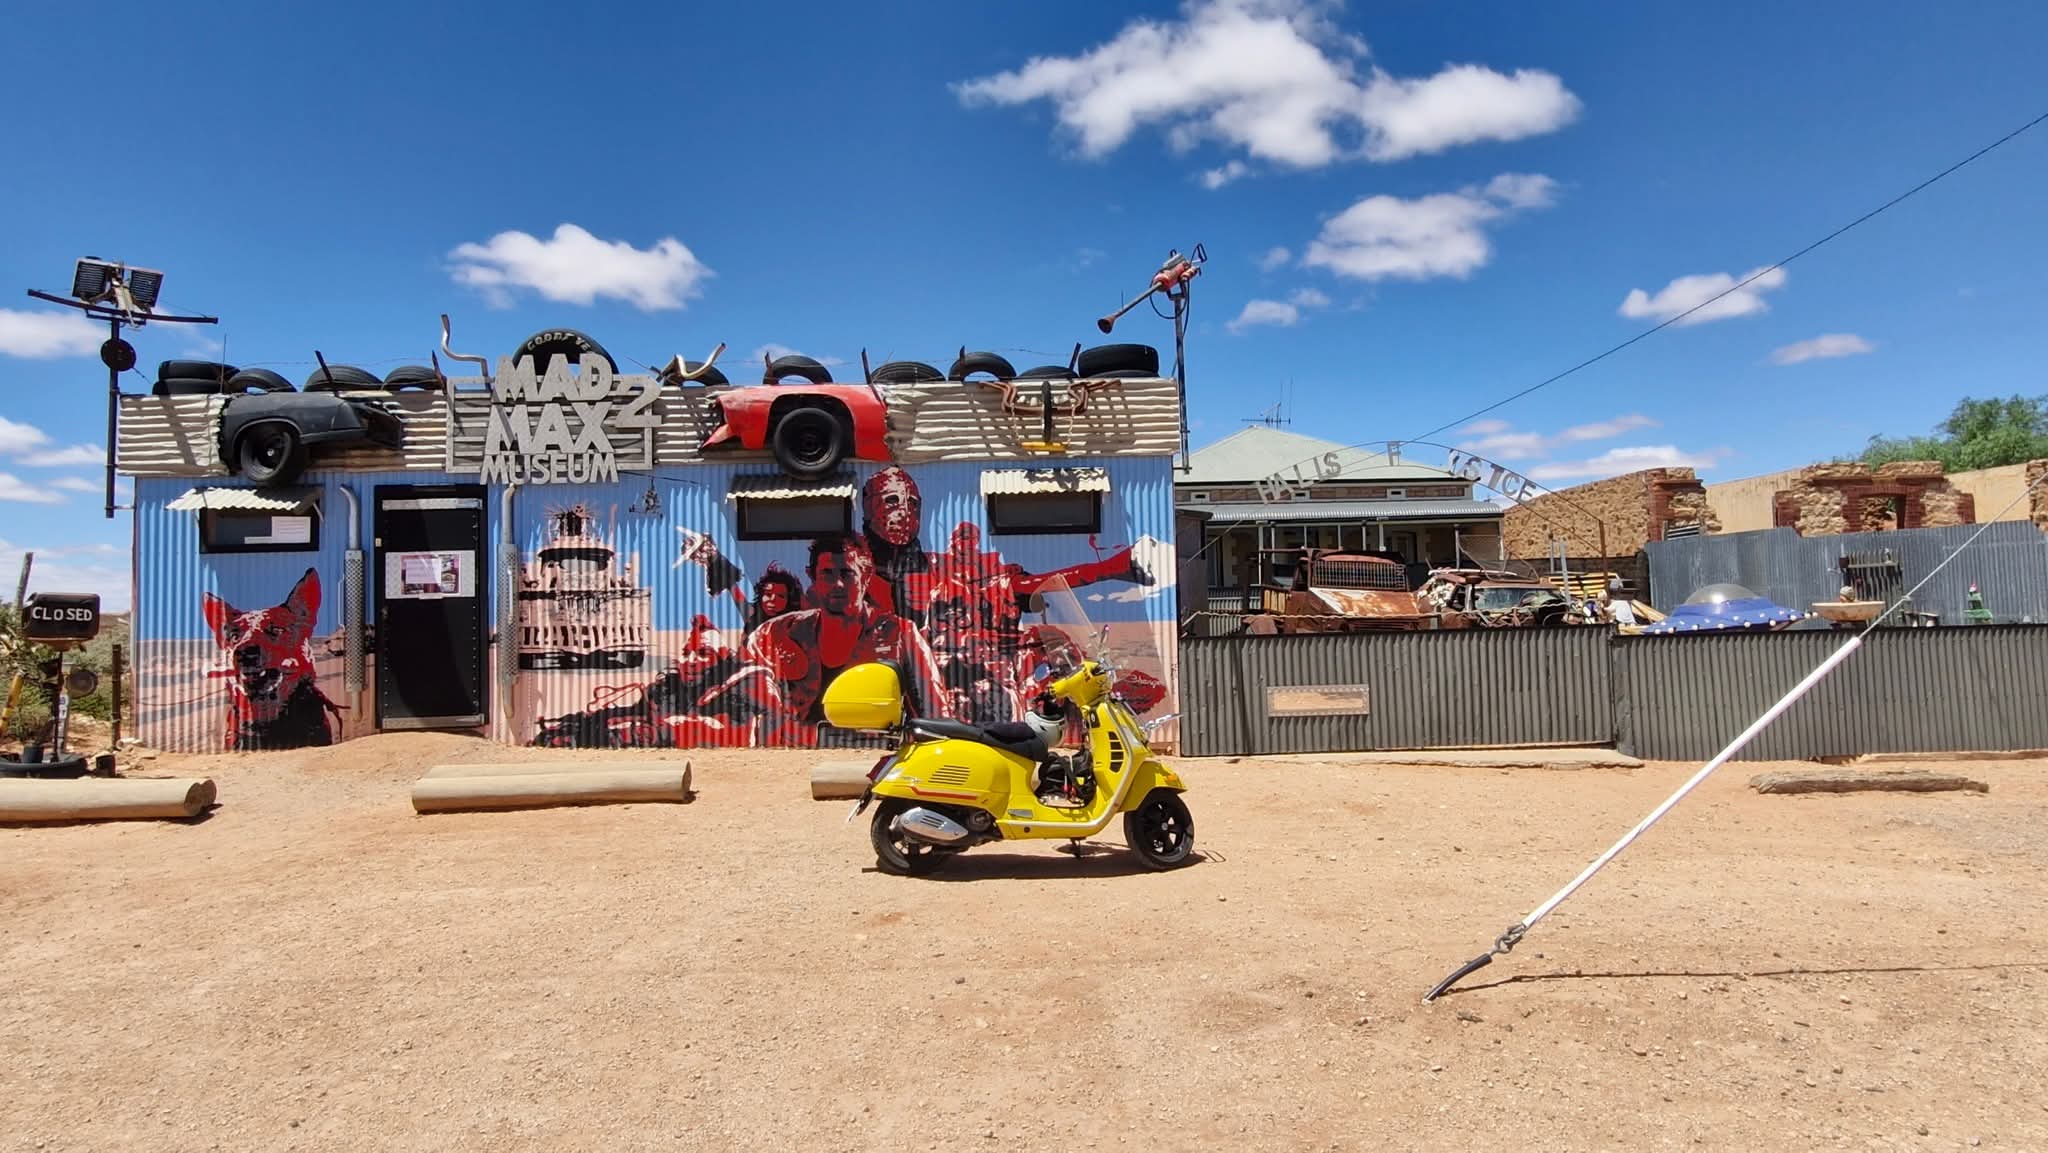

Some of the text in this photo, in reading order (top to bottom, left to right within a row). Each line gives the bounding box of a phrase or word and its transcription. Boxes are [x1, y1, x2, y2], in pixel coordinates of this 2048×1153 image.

[490, 352, 613, 402] MAD
[615, 376, 662, 428] 2
[484, 402, 616, 454] MAX
[479, 453, 619, 485] MUSEUM
[32, 606, 93, 622] CLOSED
